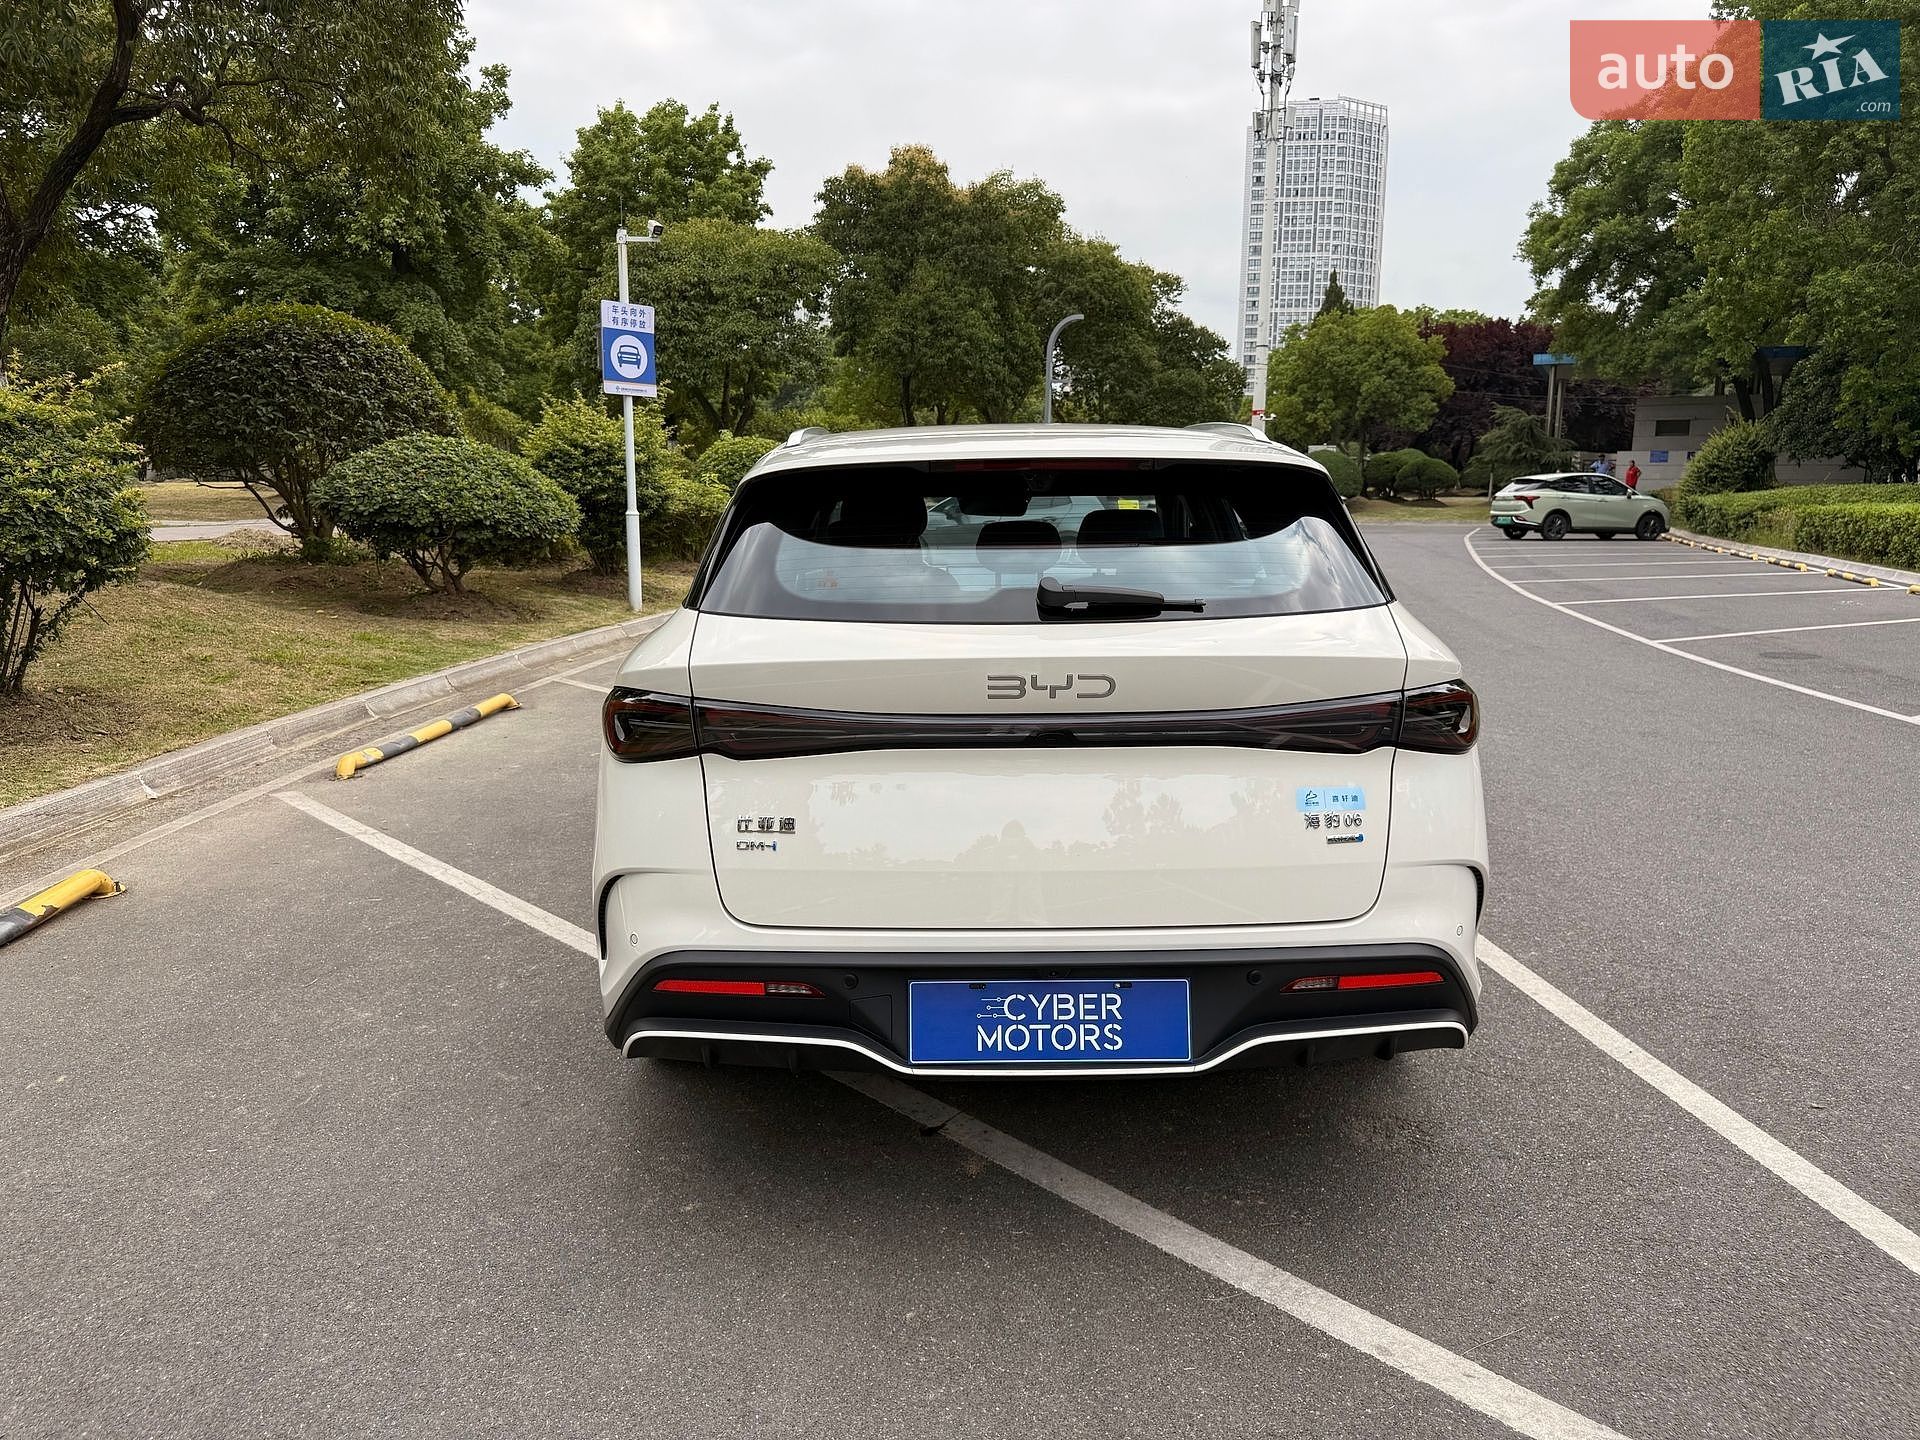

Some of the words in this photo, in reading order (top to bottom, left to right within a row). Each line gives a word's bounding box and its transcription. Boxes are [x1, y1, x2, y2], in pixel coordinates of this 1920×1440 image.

[611, 304, 647, 319] 车头向外
[611, 316, 647, 329] 有序停放
[987, 674, 1117, 700] BYD
[737, 816, 796, 834] 比亚迪
[736, 841, 777, 852] DM-i
[1003, 993, 1123, 1021] CYBER
[977, 1023, 1124, 1052] MOTORS
